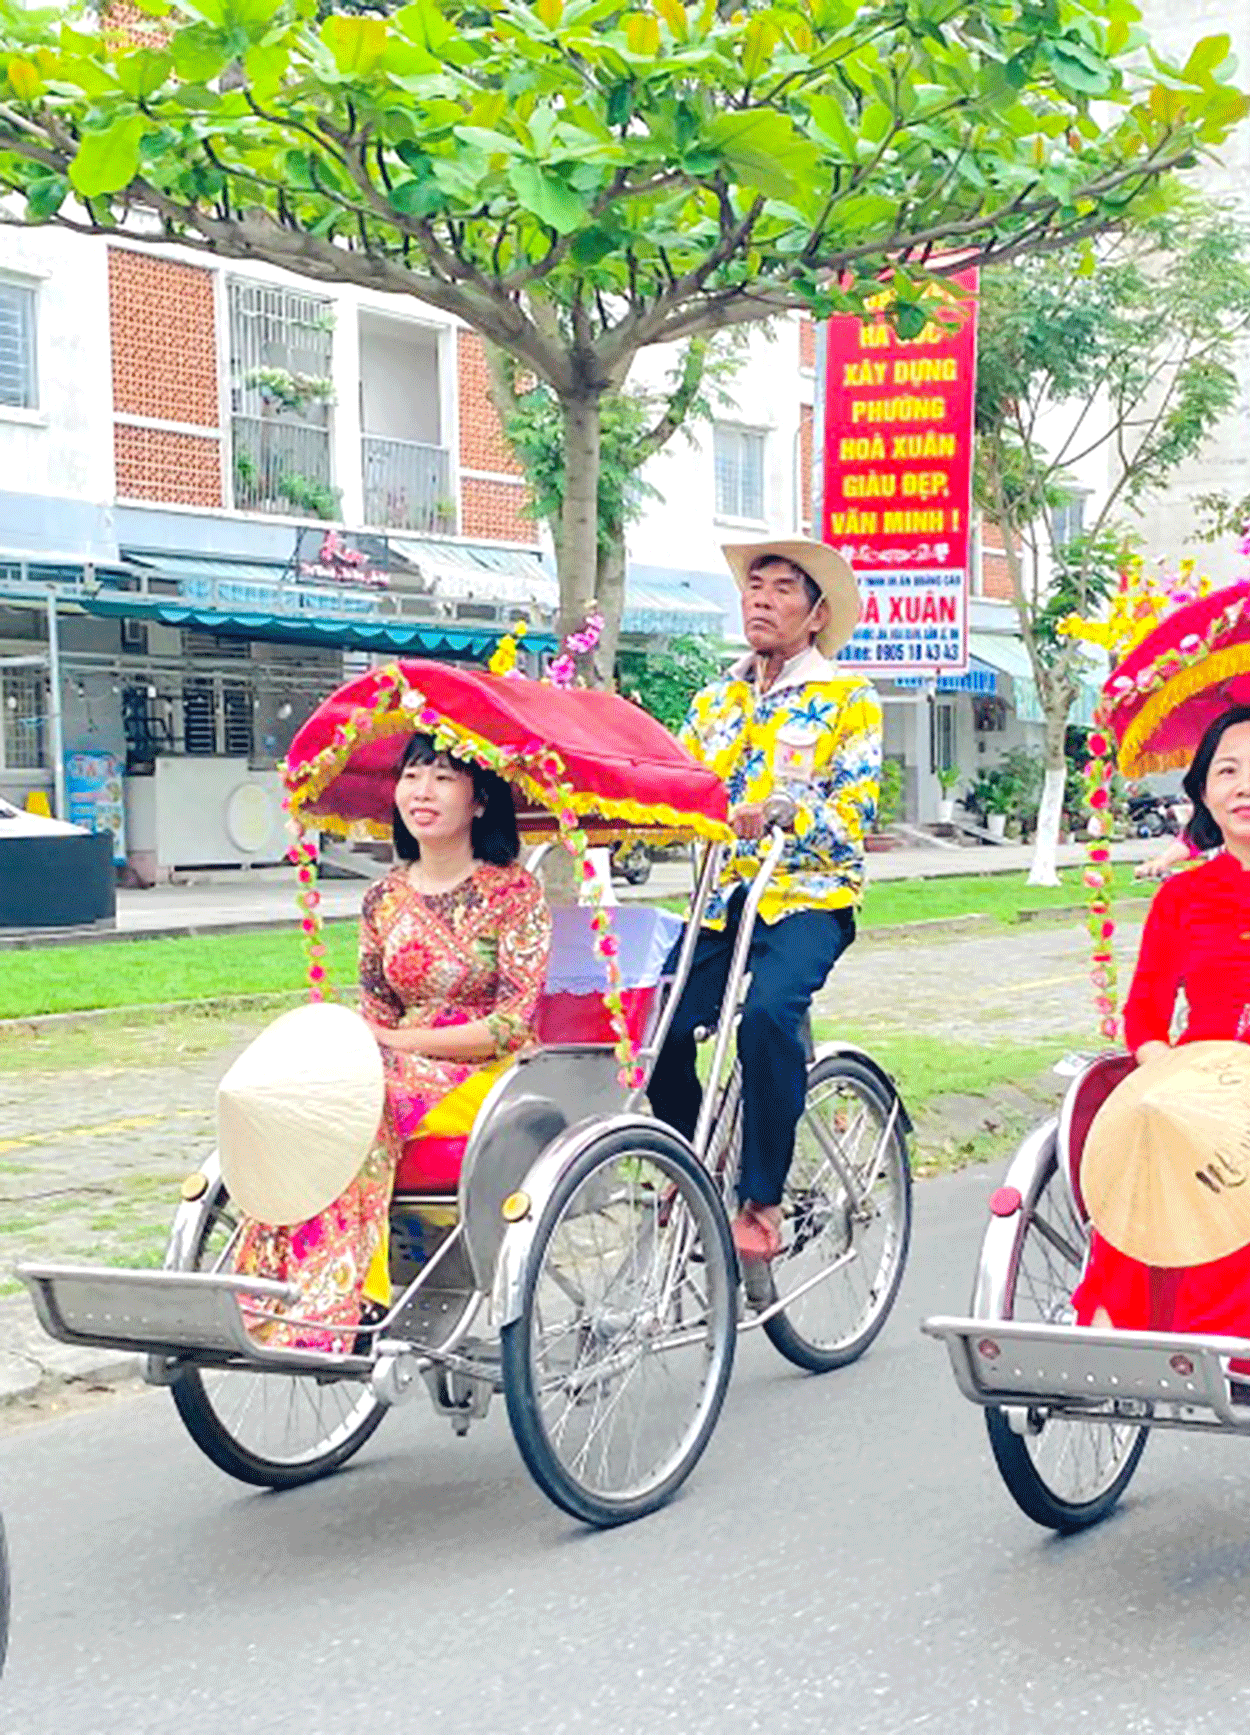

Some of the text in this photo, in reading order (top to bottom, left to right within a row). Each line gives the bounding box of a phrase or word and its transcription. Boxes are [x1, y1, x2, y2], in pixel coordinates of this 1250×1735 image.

[843, 359, 887, 386] XÂY
[892, 430, 955, 459] XUÂN
[842, 470, 896, 497] GIÀU
[831, 508, 877, 534] VĂN
[883, 509, 944, 534] MINH
[889, 590, 956, 623] XUÂN
